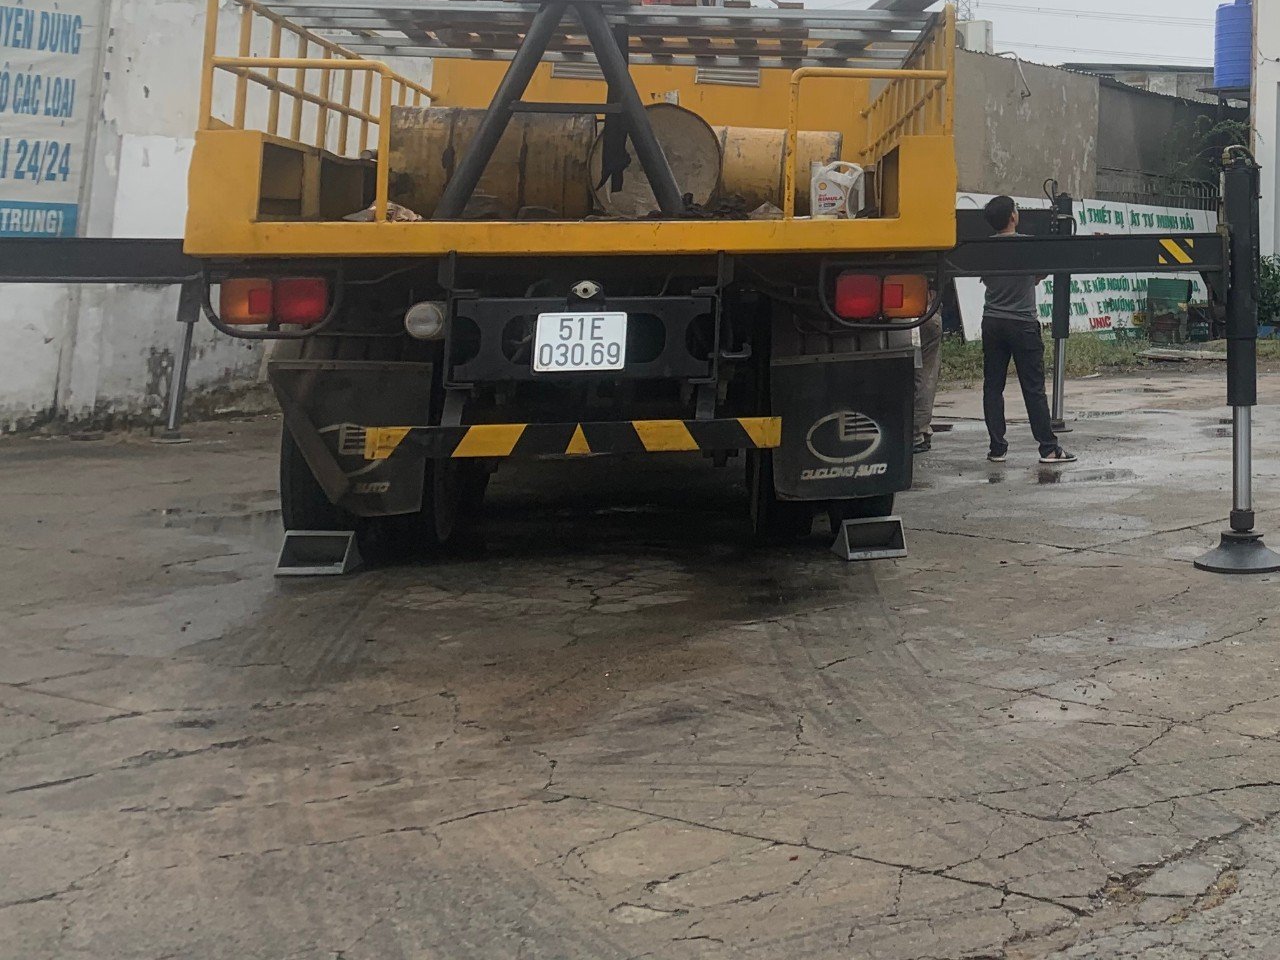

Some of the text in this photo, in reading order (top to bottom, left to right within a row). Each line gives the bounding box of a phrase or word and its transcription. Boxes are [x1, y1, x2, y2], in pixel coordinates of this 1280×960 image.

[38, 2, 82, 55] DÙNG
[13, 64, 42, 116] CÁC
[44, 76, 76, 127] LOẠI
[14, 139, 71, 185] 24/24
[1, 207, 64, 237] TRUNG)
[559, 317, 604, 341] 51E
[1089, 315, 1111, 329] UNIC
[539, 342, 621, 366] 030.69
[855, 463, 887, 478] AUTO
